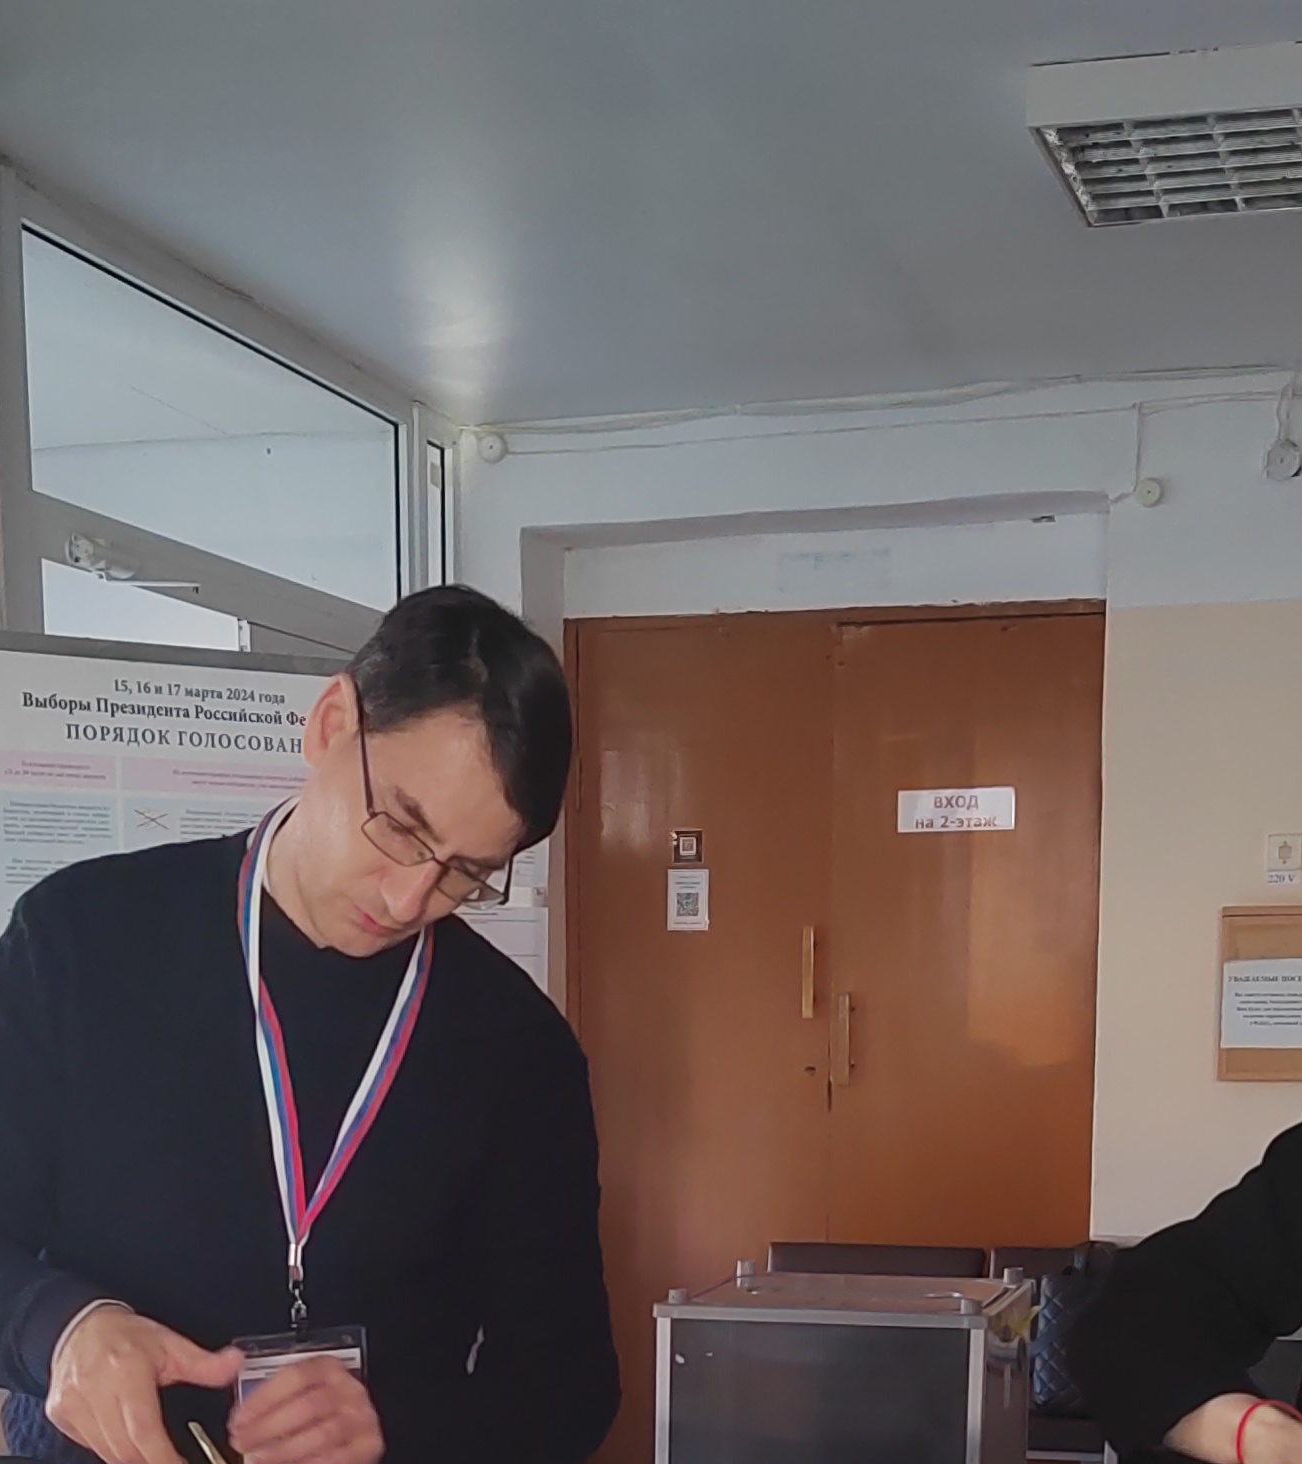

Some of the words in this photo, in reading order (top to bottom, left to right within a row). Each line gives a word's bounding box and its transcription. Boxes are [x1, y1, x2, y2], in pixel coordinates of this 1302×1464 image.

[114, 678, 133, 695] 15,
[136, 681, 152, 694] 16
[154, 684, 163, 695] и
[167, 683, 181, 696] 17
[184, 686, 223, 702] марта
[226, 688, 255, 702] 2024
[258, 692, 285, 705] года
[22, 691, 92, 715] Выборы
[96, 696, 191, 719] Президента
[194, 704, 283, 725] Российской
[65, 723, 171, 748] ПОРЯДОК
[177, 730, 302, 754] ГОЛОСОВАН
[934, 795, 979, 810] ВХОД
[915, 818, 934, 829] на
[940, 815, 998, 829] 2-этаж
[1267, 874, 1285, 883] 220
[1288, 874, 1296, 883] V
